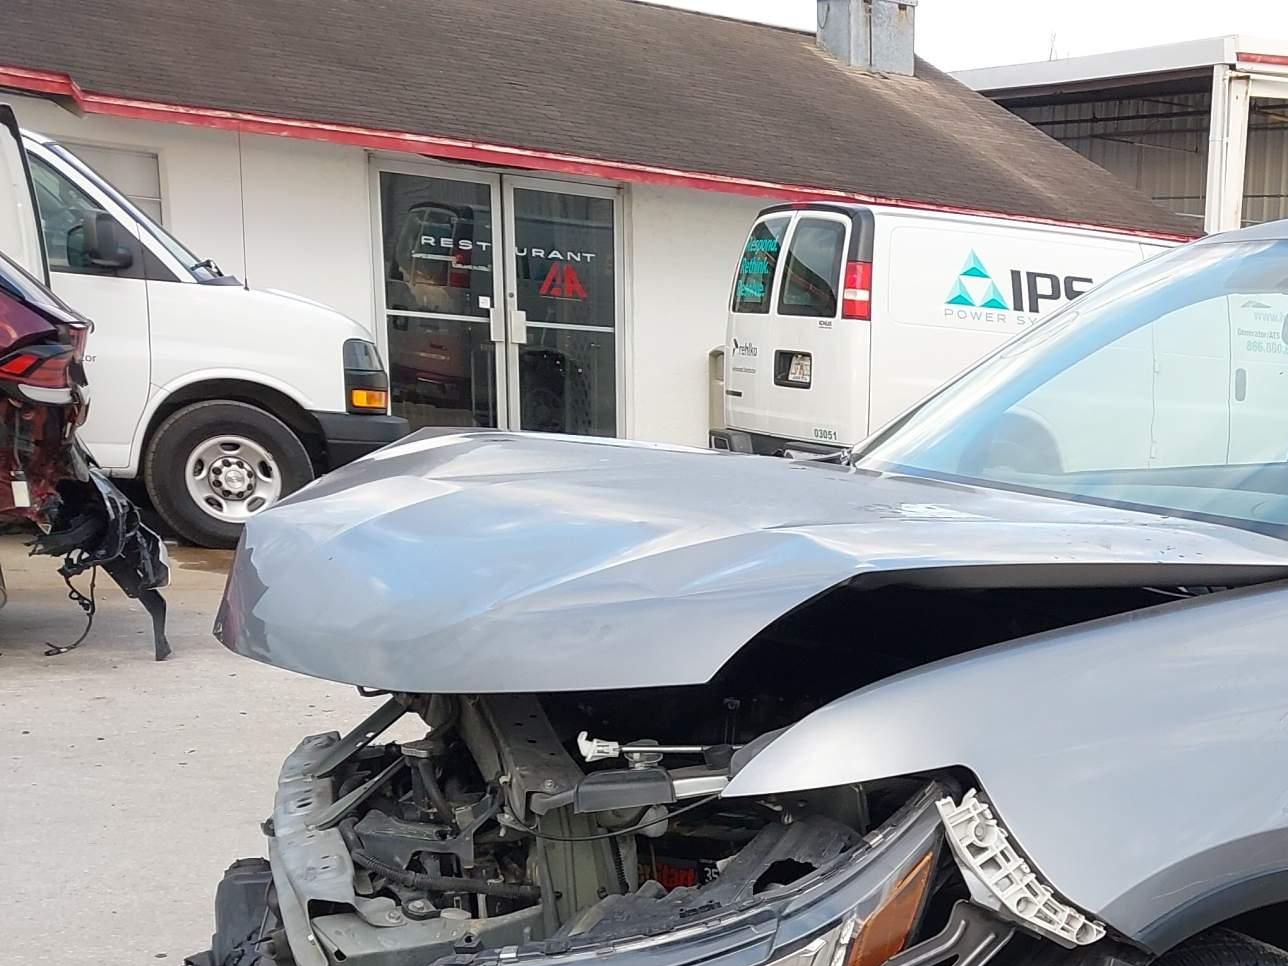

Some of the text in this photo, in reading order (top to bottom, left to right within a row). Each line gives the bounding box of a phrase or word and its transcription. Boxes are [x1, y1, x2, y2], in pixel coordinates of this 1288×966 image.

[944, 308, 1040, 327] POWER SY
[814, 428, 838, 441] 03051
